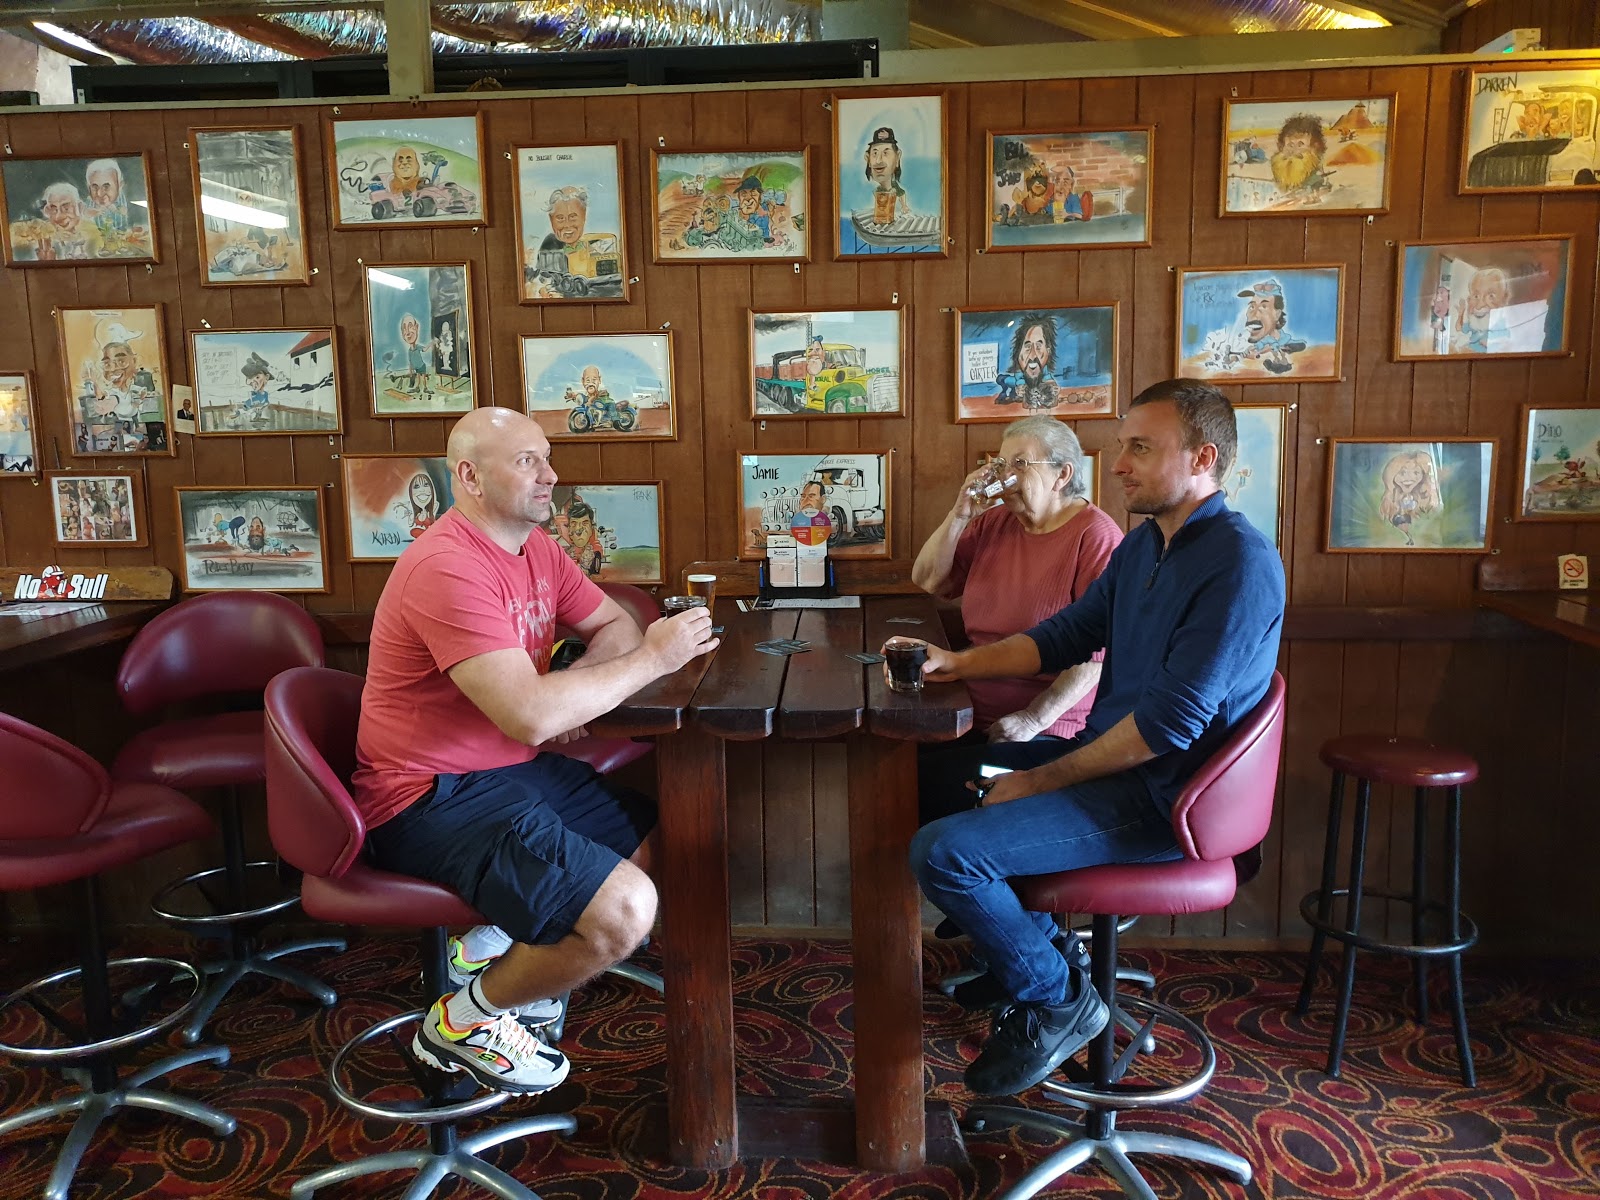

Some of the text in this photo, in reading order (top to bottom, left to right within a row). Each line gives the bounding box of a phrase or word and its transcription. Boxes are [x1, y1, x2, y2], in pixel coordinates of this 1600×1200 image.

[1474, 72, 1518, 97] DARREN
[752, 464, 780, 480] JAMIE
[14, 574, 109, 599] No Bull
